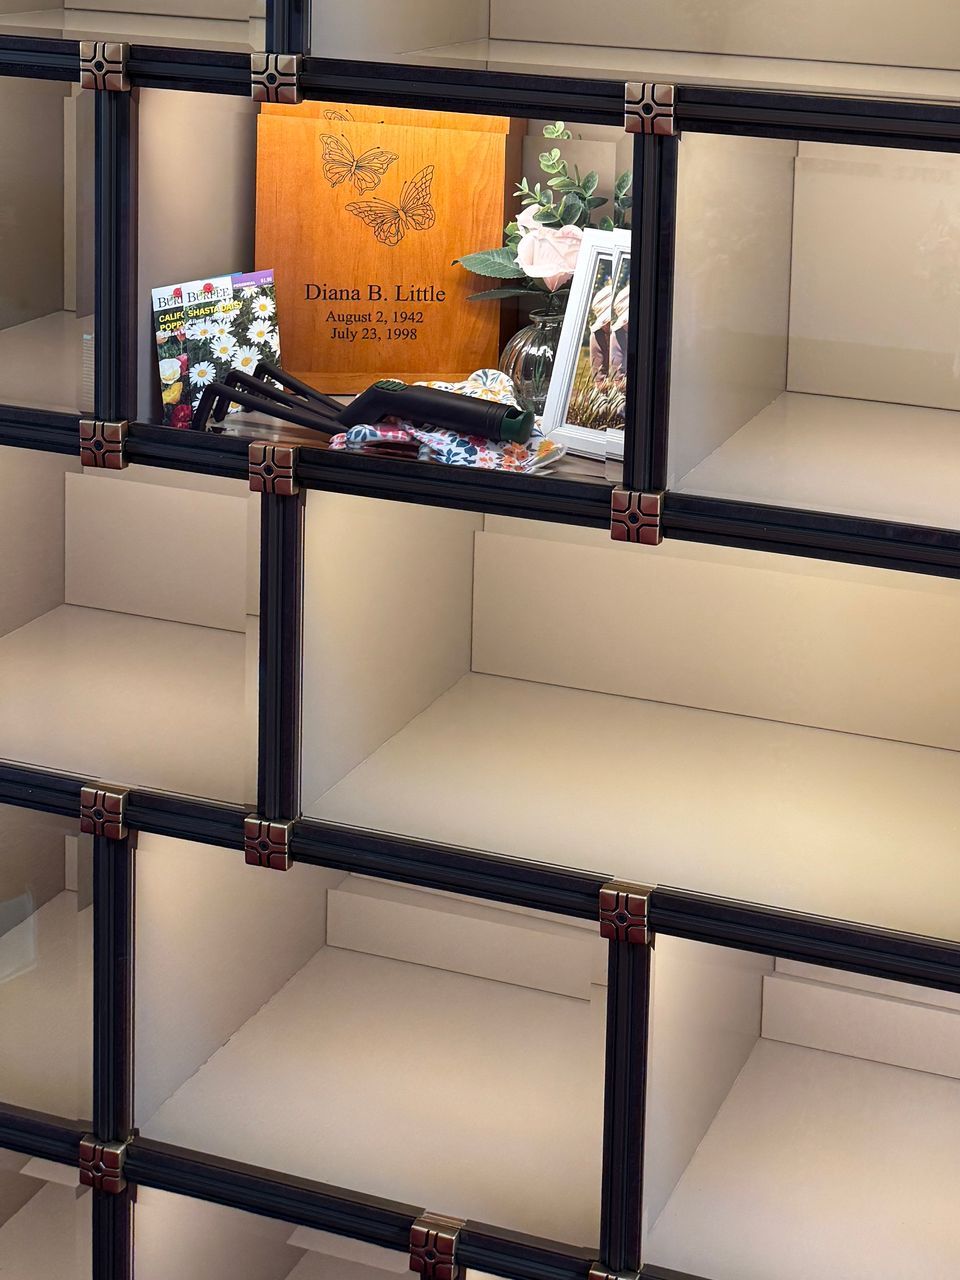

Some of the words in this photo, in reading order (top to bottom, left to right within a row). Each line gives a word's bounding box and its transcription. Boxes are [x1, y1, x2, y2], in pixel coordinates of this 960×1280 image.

[187, 287, 231, 303] BURPEE
[305, 283, 361, 301] Diana
[367, 284, 388, 301] B.
[395, 283, 446, 302] Little
[188, 304, 219, 317] SHASTA
[220, 300, 243, 312] DAISY
[326, 310, 372, 325] August
[375, 311, 388, 325] 2,
[393, 311, 424, 323] 1942
[330, 327, 358, 342] July
[361, 328, 382, 341] 23,
[387, 328, 417, 340] 1998
